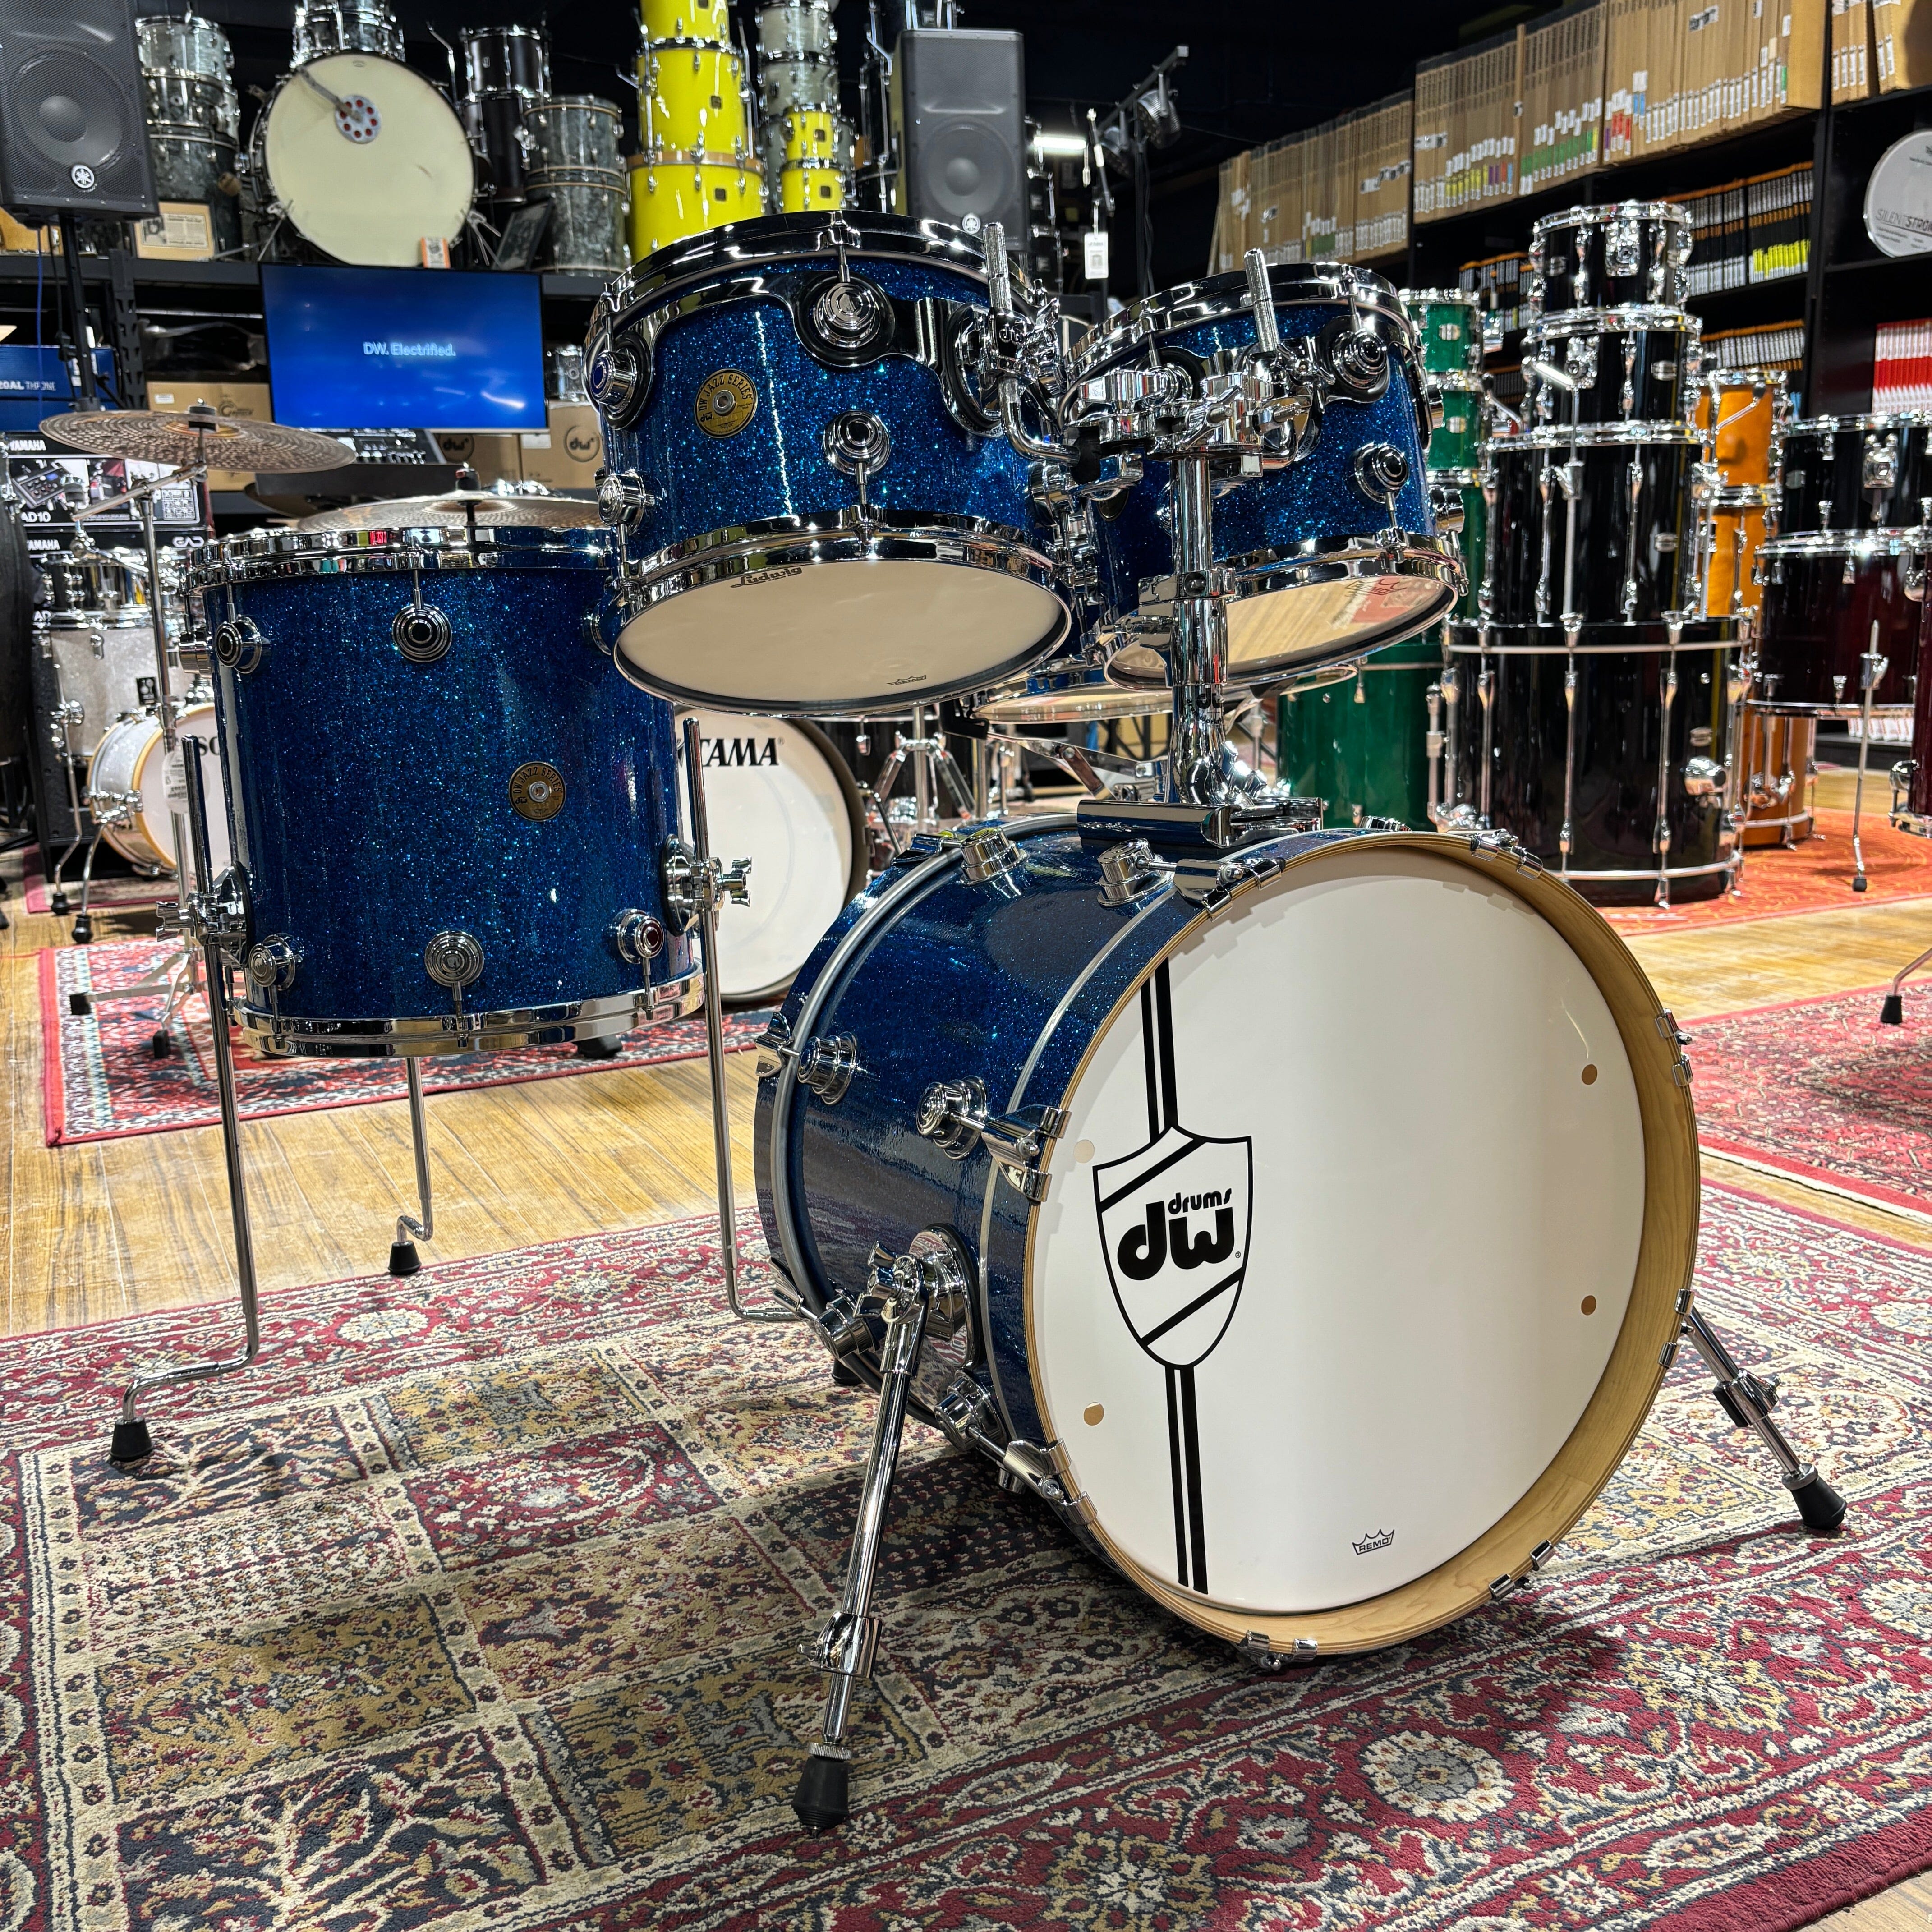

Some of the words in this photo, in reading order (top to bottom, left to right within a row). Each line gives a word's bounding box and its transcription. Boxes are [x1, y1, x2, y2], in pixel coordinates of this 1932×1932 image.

[390, 341, 456, 356] Electrified.
[703, 375, 725, 397] JAZZ
[727, 374, 754, 400] SERIES
[9, 440, 46, 451] YAMAHA
[27, 539, 60, 551] AMAHA
[730, 567, 802, 588] Ludwig
[700, 737, 779, 767] TAMA
[518, 767, 538, 783] JAZZ
[541, 767, 563, 793] SERIES
[1167, 1187, 1232, 1215] drums
[1117, 1200, 1235, 1281] dw
[1358, 1537, 1390, 1552] REMO
